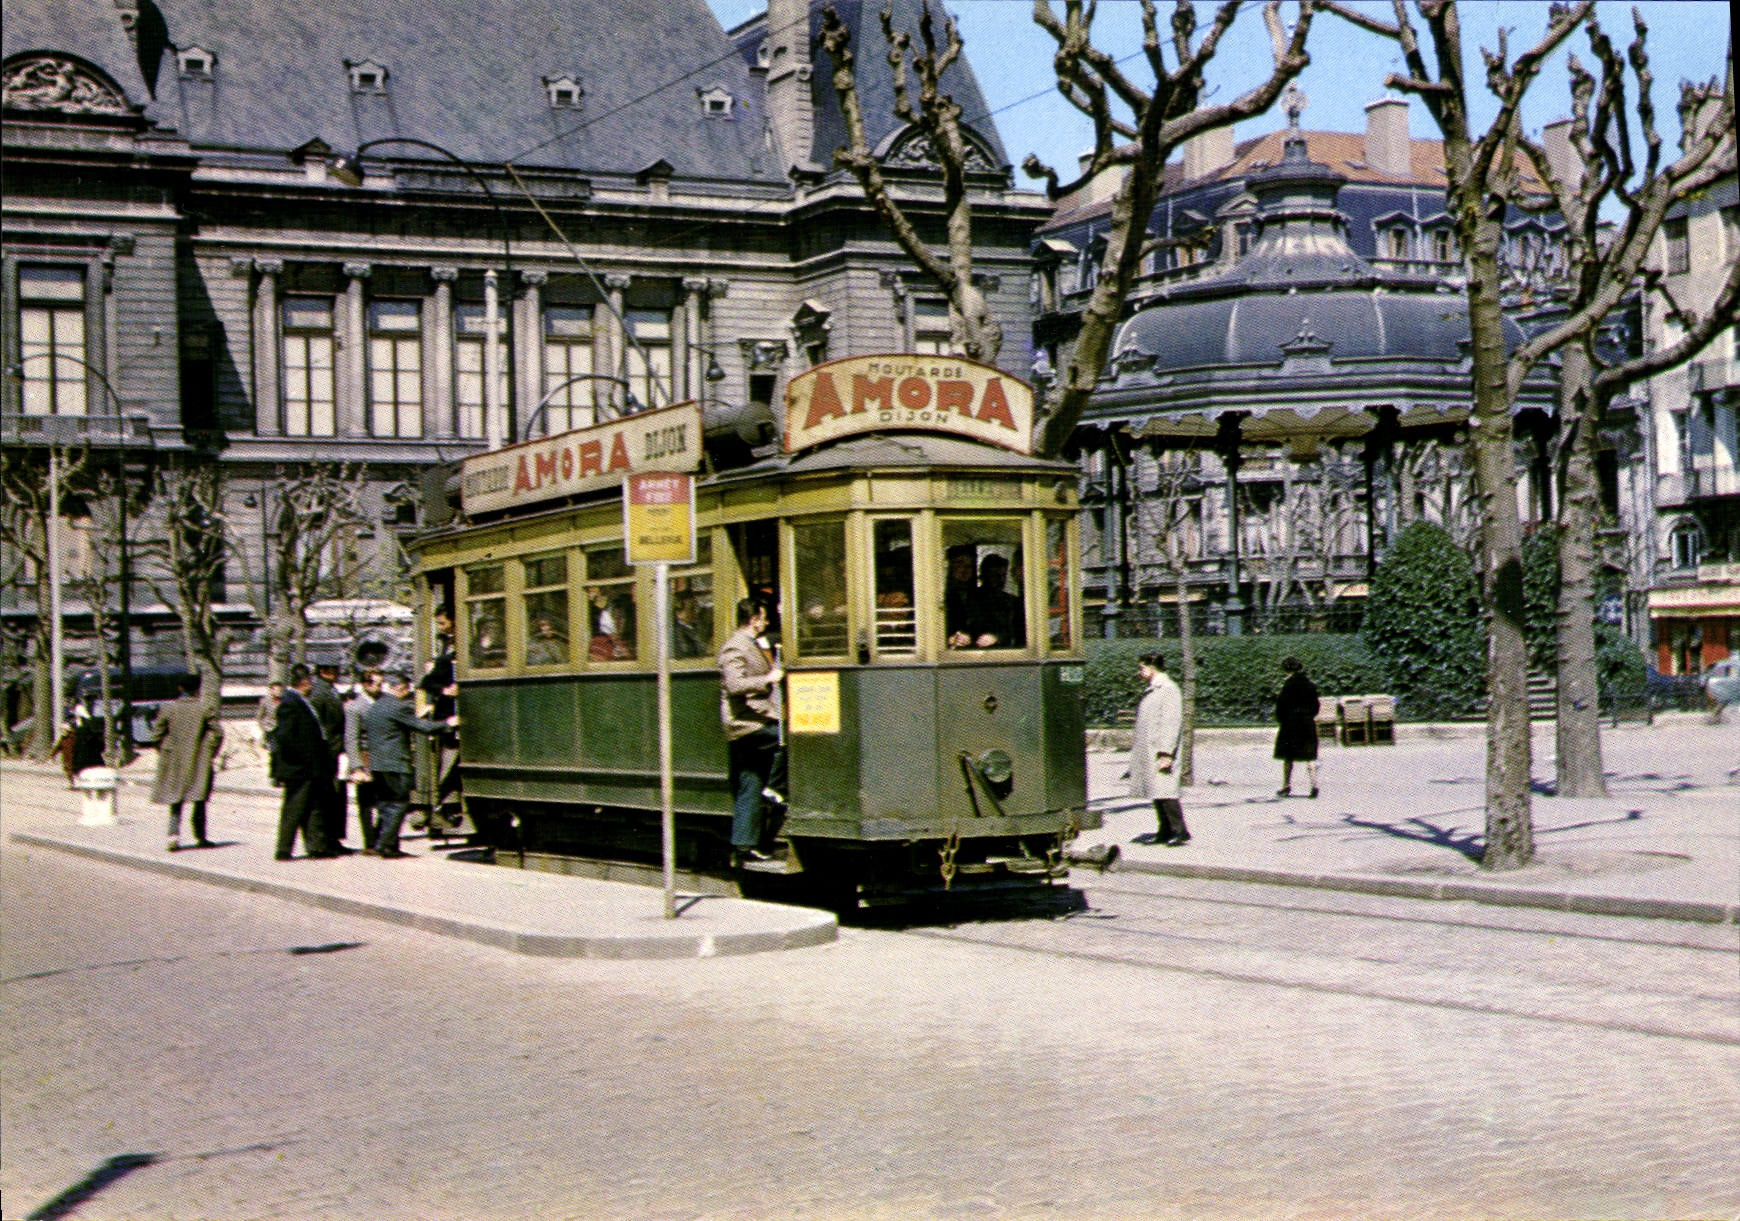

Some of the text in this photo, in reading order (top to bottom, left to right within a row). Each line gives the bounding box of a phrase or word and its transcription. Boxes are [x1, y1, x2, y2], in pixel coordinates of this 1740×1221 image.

[803, 371, 1018, 432] AMORA
[879, 411, 948, 424] DIJON
[512, 431, 633, 497] AMORA
